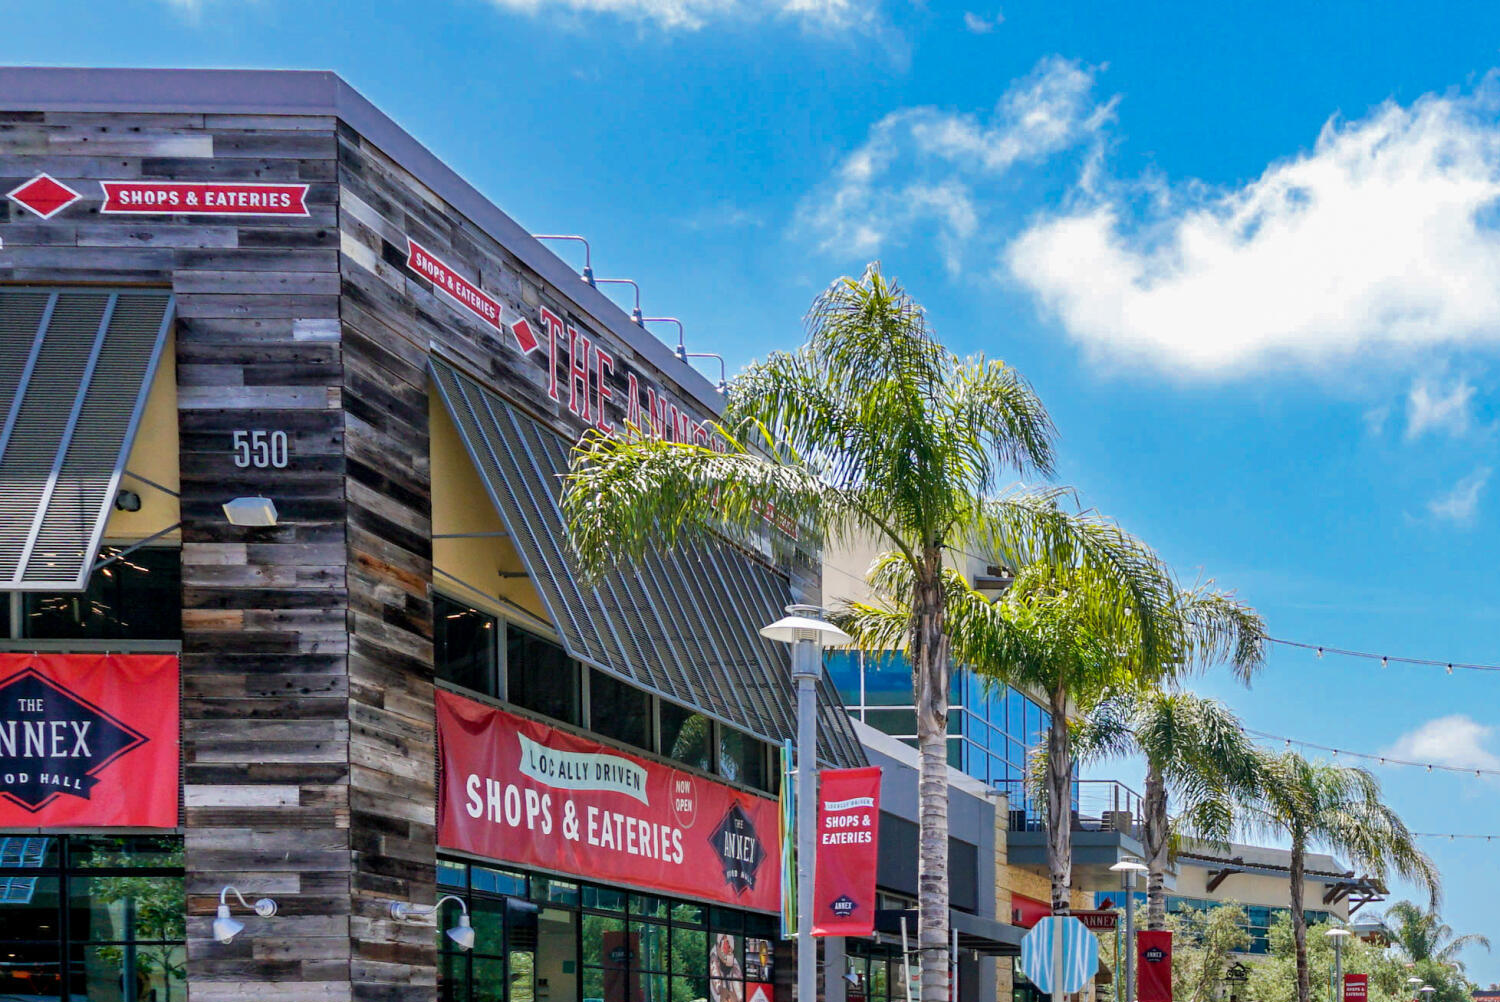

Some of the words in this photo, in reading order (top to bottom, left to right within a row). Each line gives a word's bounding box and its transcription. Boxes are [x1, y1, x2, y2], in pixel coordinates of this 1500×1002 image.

[119, 190, 179, 205] SHOPS
[186, 191, 198, 205] &
[205, 191, 291, 207] EATERIES
[415, 252, 445, 283] SHOPS
[447, 275, 454, 290] &
[456, 284, 496, 320] EATERIES
[540, 304, 615, 440] THE
[233, 430, 288, 468] 550
[18, 698, 44, 712] THE
[530, 749, 589, 781] LOCALLY
[595, 761, 641, 792] DRIVEN
[40, 773, 82, 790] HALL
[675, 780, 691, 794] NOW
[675, 798, 692, 812] OPEN
[465, 774, 553, 835] SHOPS
[562, 800, 580, 841] &
[587, 805, 684, 865] EATERIES
[825, 815, 860, 828] SHOPS
[861, 814, 871, 826] &
[822, 831, 872, 845] EATERIES
[1083, 915, 1116, 927] ANNEX
